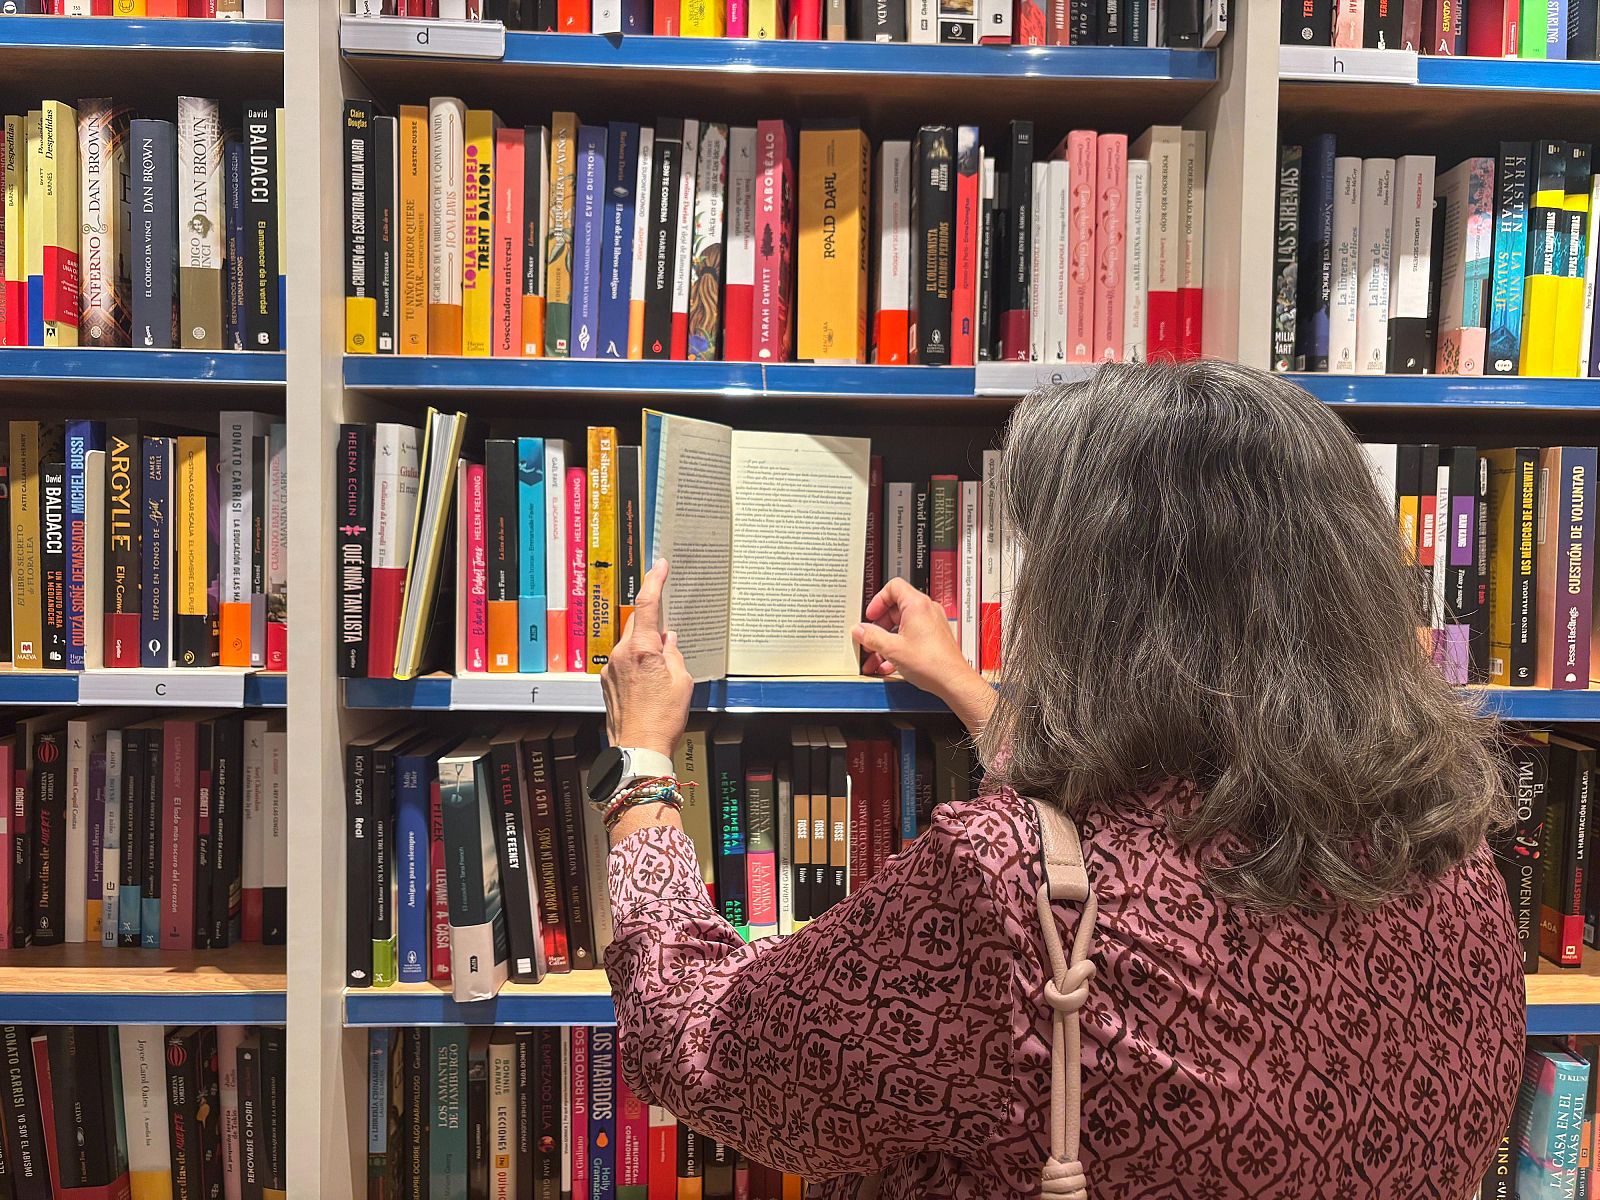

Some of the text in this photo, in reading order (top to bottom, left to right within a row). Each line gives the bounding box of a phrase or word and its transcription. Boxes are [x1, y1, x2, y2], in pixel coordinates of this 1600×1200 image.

[416, 28, 428, 44] d
[1442, 1, 1450, 32] CADÁVER
[1334, 57, 1344, 73] h
[45, 110, 54, 160] Despedidas
[248, 110, 268, 118] David
[7, 123, 15, 171] Despedidas
[143, 139, 155, 182] BROWN
[193, 117, 206, 214] DAN BROWN
[250, 124, 268, 202] BALDACCI
[352, 140, 364, 162] WARD
[352, 164, 364, 190] EMILIA
[762, 133, 775, 212] SABORÉALO
[824, 173, 836, 209] DAHL
[1501, 156, 1514, 233] HANNAH
[88, 118, 102, 308] INFERNO DAN BROWN
[144, 186, 153, 213] DAN
[352, 192, 365, 234] ESCRITORA
[407, 200, 416, 234] QUIERE
[466, 145, 477, 288] LOLA EN EL ESPEJO
[1280, 168, 1298, 263] LAS SIRENAS
[1512, 157, 1526, 233] KRISTIN
[478, 164, 490, 271] TRENT DALTON
[824, 215, 835, 259] ROALD
[146, 245, 151, 255] DA
[353, 245, 364, 254] de
[353, 255, 365, 286] CRIMEN
[928, 229, 938, 280] COLECCIONISTA
[938, 223, 949, 298] DE CUADROS PERDIDOS
[259, 269, 266, 277] de
[405, 282, 414, 306] NIÑO
[503, 237, 512, 350] Cosechadora universal
[1338, 243, 1349, 305] La librera de
[406, 308, 414, 320] TU
[761, 268, 770, 342] TARAH DeWITT
[1052, 374, 1062, 385] e
[232, 425, 242, 512] DONATO CARRISI
[348, 432, 357, 516] HELENA ECHLIN
[592, 469, 600, 488] que
[601, 440, 610, 494] El silencio
[112, 436, 130, 551] ARGYLLE
[934, 487, 944, 542] FERRANTE
[945, 498, 954, 530] ELENA
[46, 487, 62, 554] BALDACCI
[591, 511, 600, 548] separa
[917, 493, 926, 568] David Foenkinos
[1520, 462, 1533, 575] LOS MÉDICOS DE AUSCHWITZ
[1567, 467, 1584, 594] CUESTIÓN DE VOLUNTAD
[71, 436, 84, 646] QUIZÁ SOÑÉ DEMASIADO MICHEL BUSSI
[572, 547, 583, 569] Jones
[344, 544, 363, 642] QUÉ NIÑA TAN LISTA
[571, 570, 584, 596] Bridget
[1568, 607, 1578, 642] Hastings
[156, 683, 166, 696] c
[532, 686, 539, 703] f
[355, 756, 364, 776] Katy
[532, 751, 548, 816] LUCY FOLEY
[721, 772, 729, 824] MENTIRA
[1517, 761, 1534, 821] MUSEO
[1534, 784, 1544, 795] EL
[356, 818, 364, 838] Real
[730, 780, 738, 847] LA PRIMERA
[798, 819, 807, 839] FOSSE
[815, 819, 824, 839] FOSSE
[834, 822, 843, 842] FOSSE
[1578, 804, 1586, 848] HABITACIÓN
[504, 812, 519, 868] ALICE FEENEY
[1577, 850, 1583, 860] LA
[407, 880, 416, 907] Amigas
[537, 828, 559, 924] UN APARTAMENTO EN PARÍS
[1518, 866, 1533, 939] OWEN KING
[4, 1027, 19, 1065] DONATO
[10, 1066, 25, 1108] CARRISI
[438, 1046, 448, 1127] LOS AMANTES
[449, 1044, 458, 1128] DE HAMBURGO
[576, 1048, 584, 1114] UN RAYO DE
[593, 1055, 612, 1120] MARIDOS
[17, 1113, 25, 1123] YO
[19, 1125, 28, 1139] SOY
[498, 1107, 508, 1151] LECCIONES
[247, 1139, 256, 1183] RENOVARSE
[1550, 1093, 1571, 1188] LA CASA EN EL
[1564, 1094, 1584, 1200] MAR MÁS AZUL
[23, 1150, 32, 1177] ABISMO
